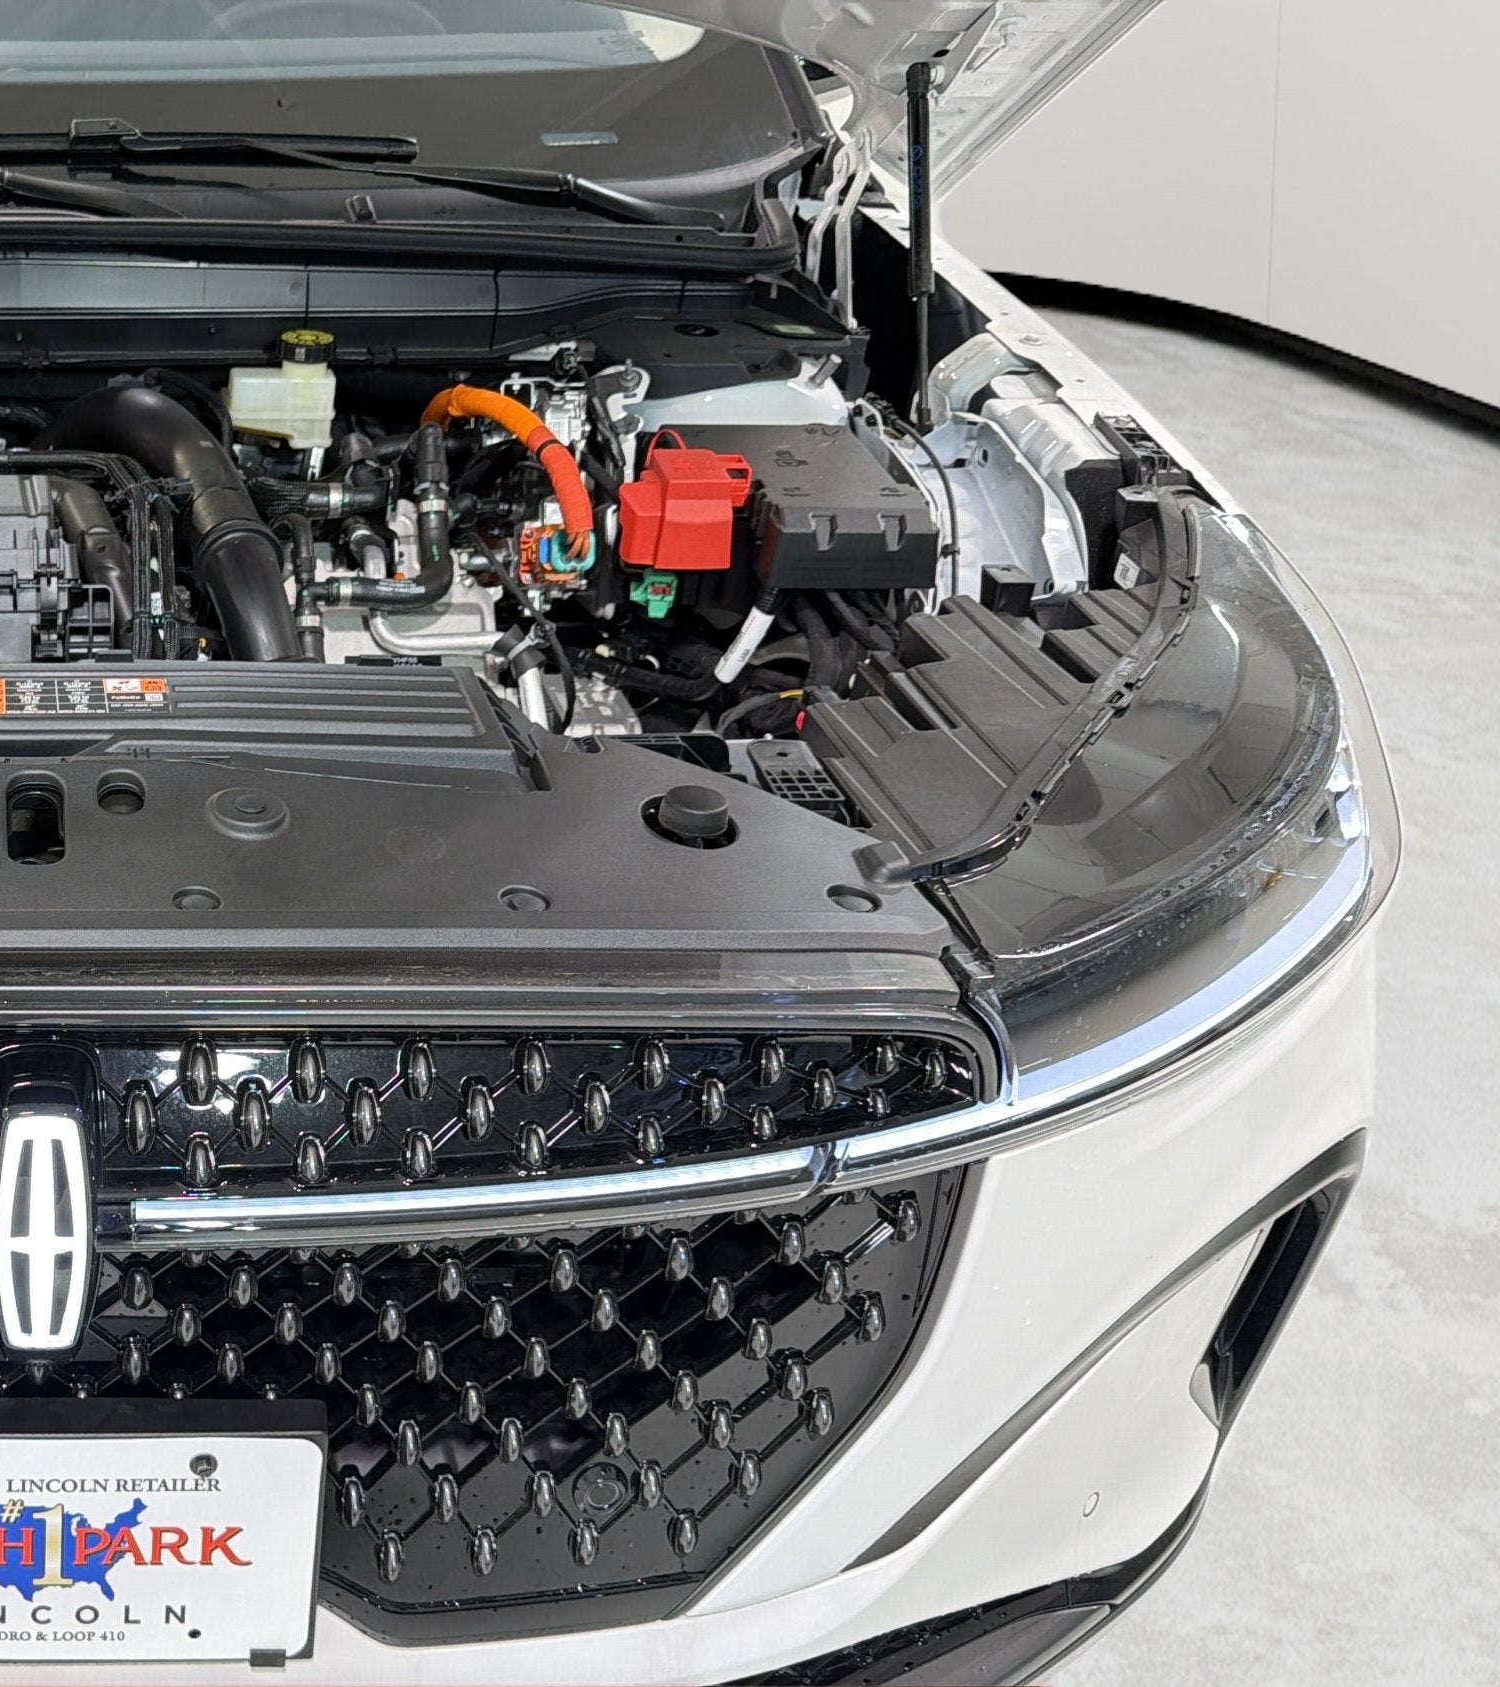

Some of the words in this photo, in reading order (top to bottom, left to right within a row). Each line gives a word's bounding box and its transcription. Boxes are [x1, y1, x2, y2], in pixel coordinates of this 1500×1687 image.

[6, 1478, 109, 1494] LINCOLN
[115, 1478, 222, 1493] RETAILER
[73, 1526, 254, 1567] PARK
[35, 1630, 49, 1642] &
[52, 1630, 96, 1642] LOOP
[100, 1630, 125, 1642] 410
